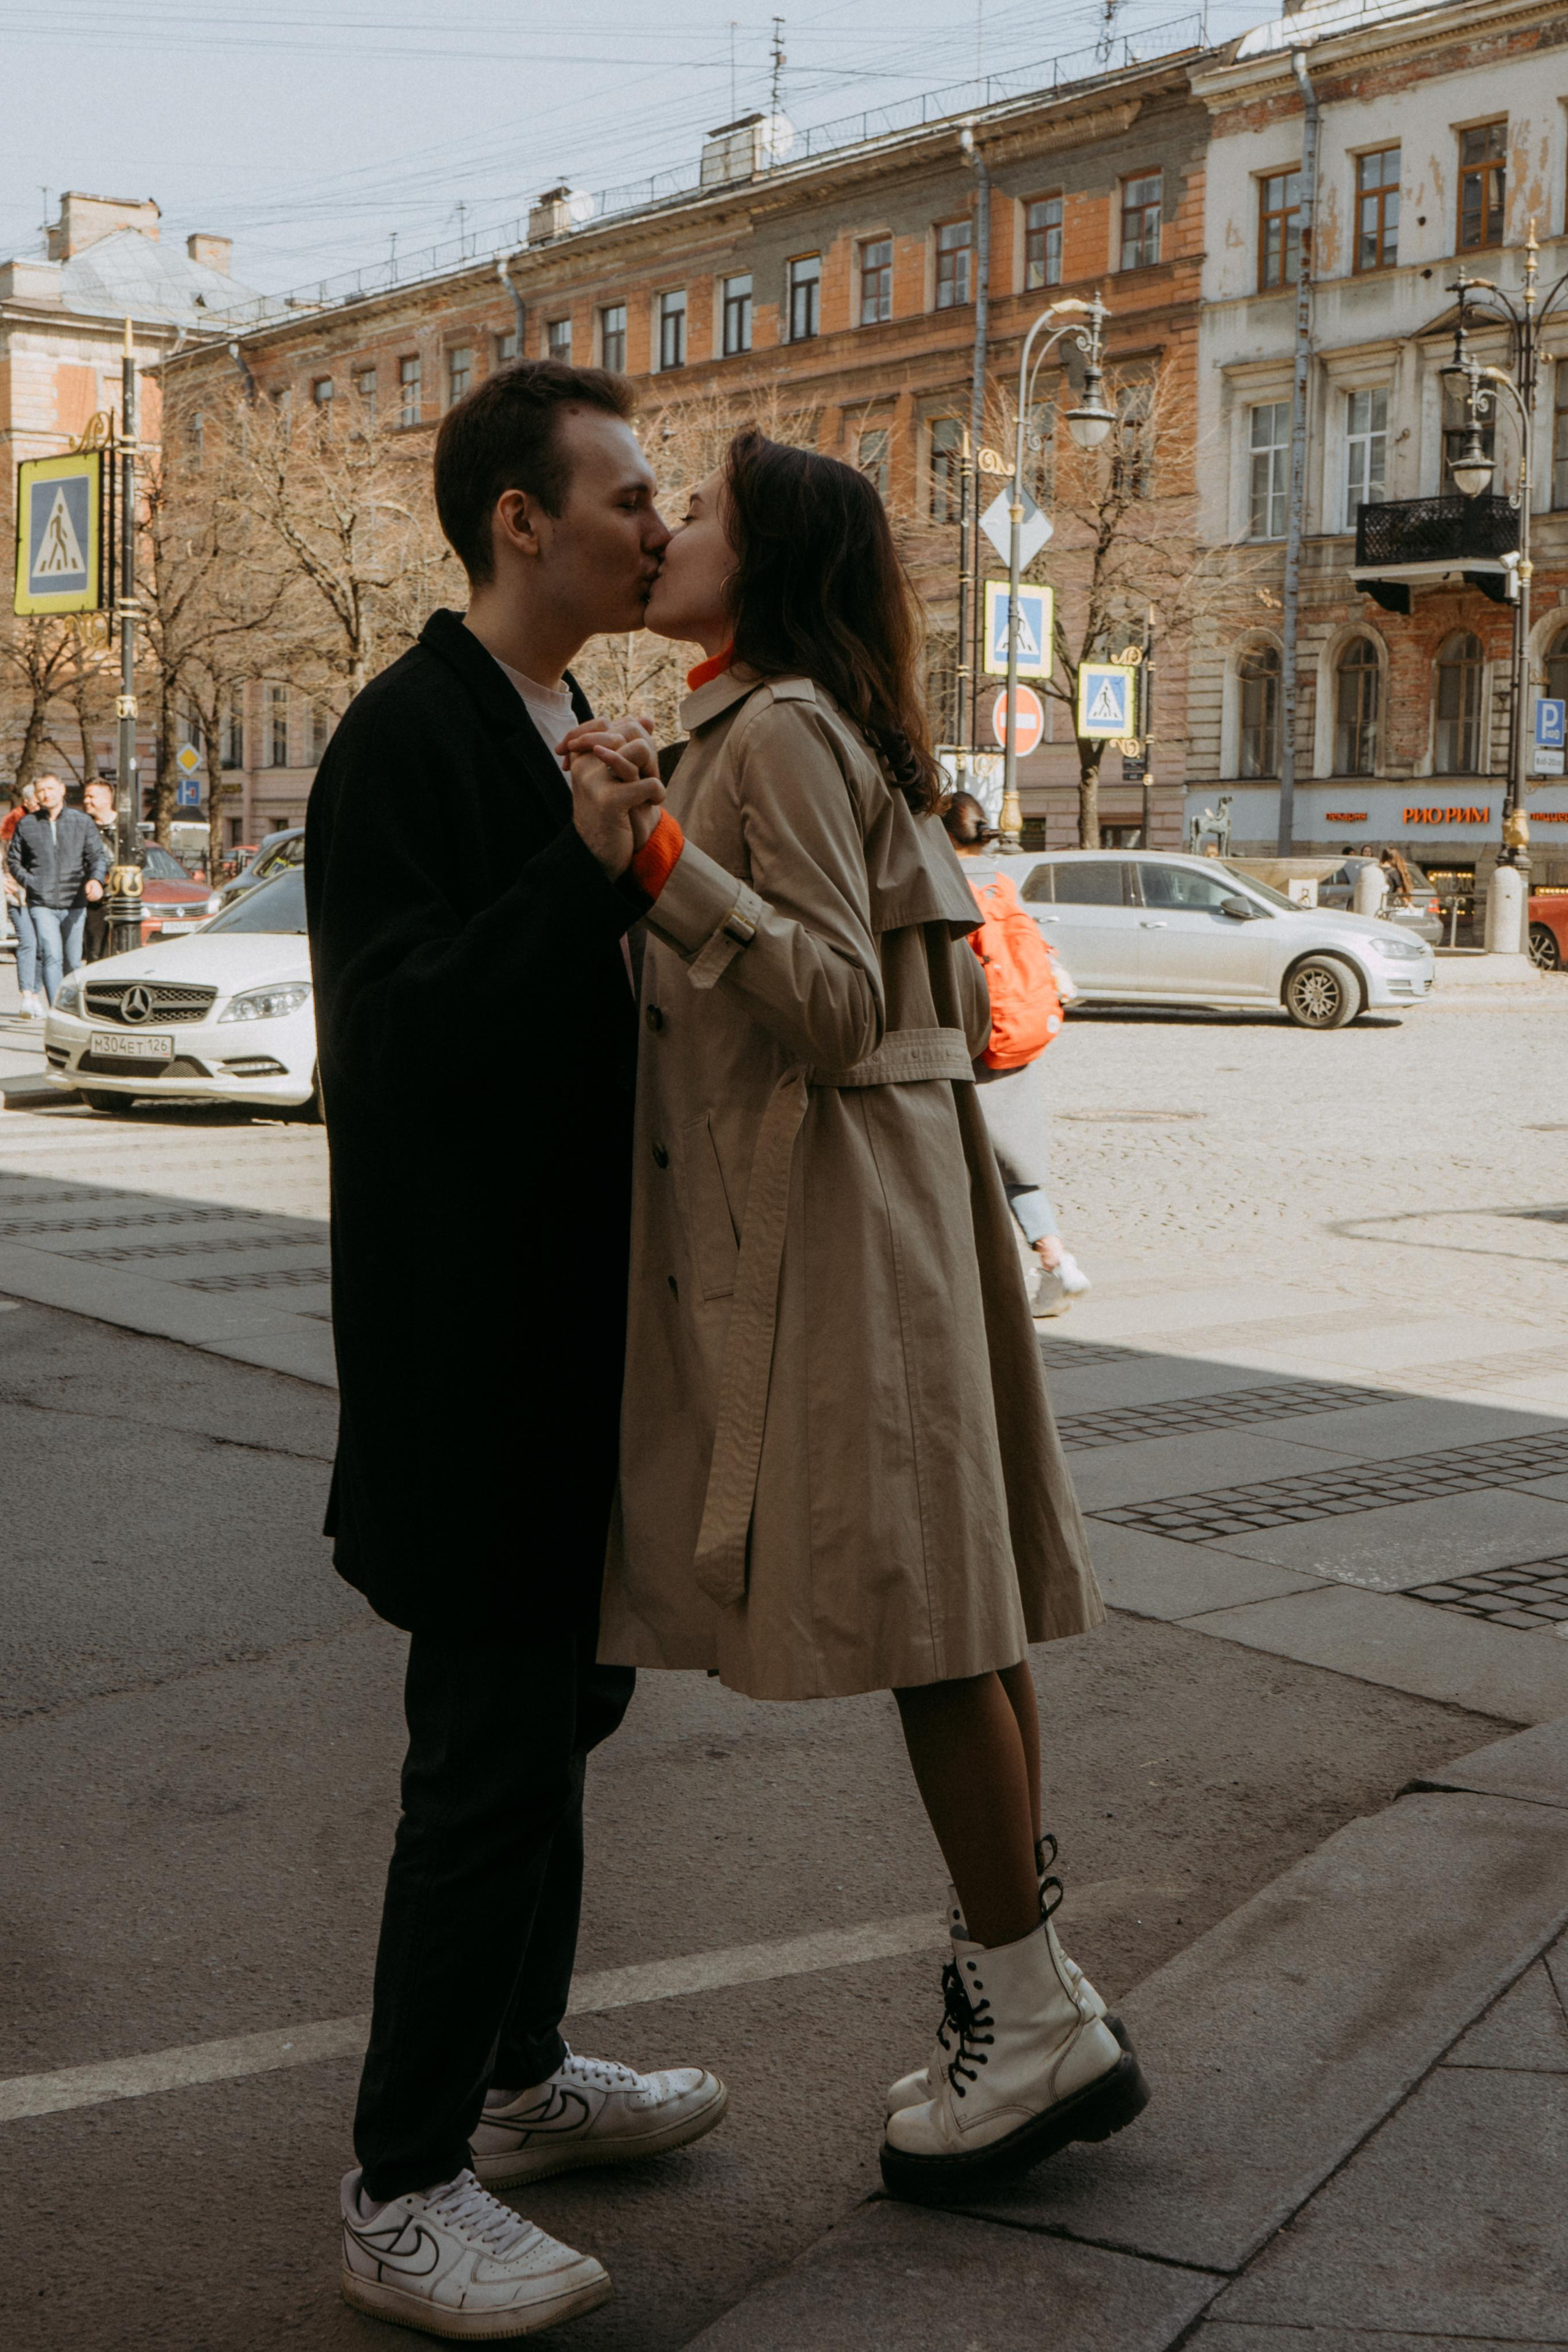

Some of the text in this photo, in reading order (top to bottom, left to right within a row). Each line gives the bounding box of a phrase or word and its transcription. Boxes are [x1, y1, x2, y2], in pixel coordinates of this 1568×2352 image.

[1403, 807, 1489, 824] РИО РИМ
[95, 1036, 167, 1054] М304ЕТ 126
